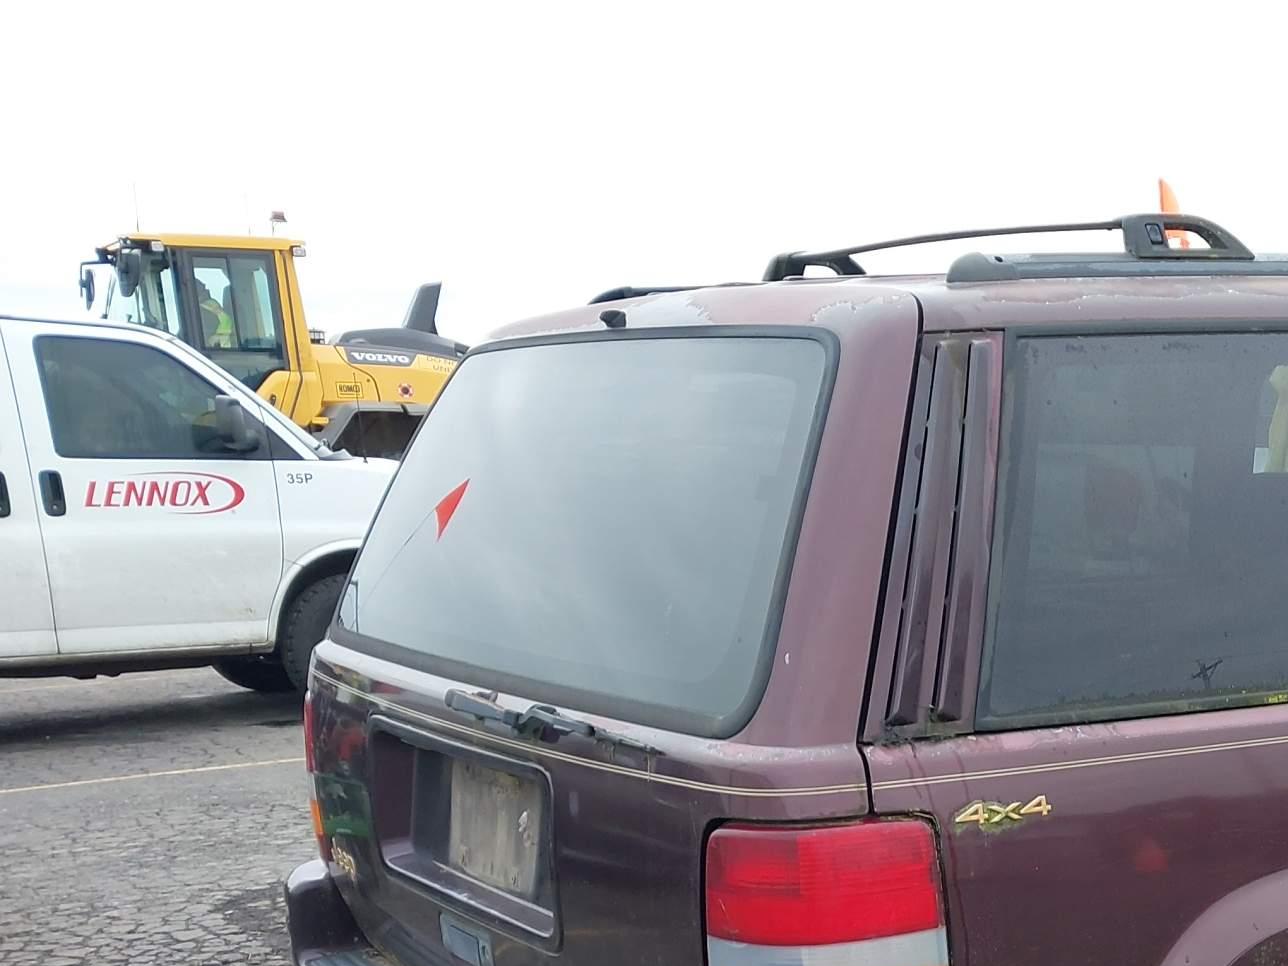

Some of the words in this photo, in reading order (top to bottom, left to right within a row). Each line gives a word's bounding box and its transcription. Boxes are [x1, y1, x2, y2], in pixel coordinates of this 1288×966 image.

[350, 351, 410, 364] VOLVO
[286, 472, 314, 484] 35P
[84, 480, 212, 508] LENNOX
